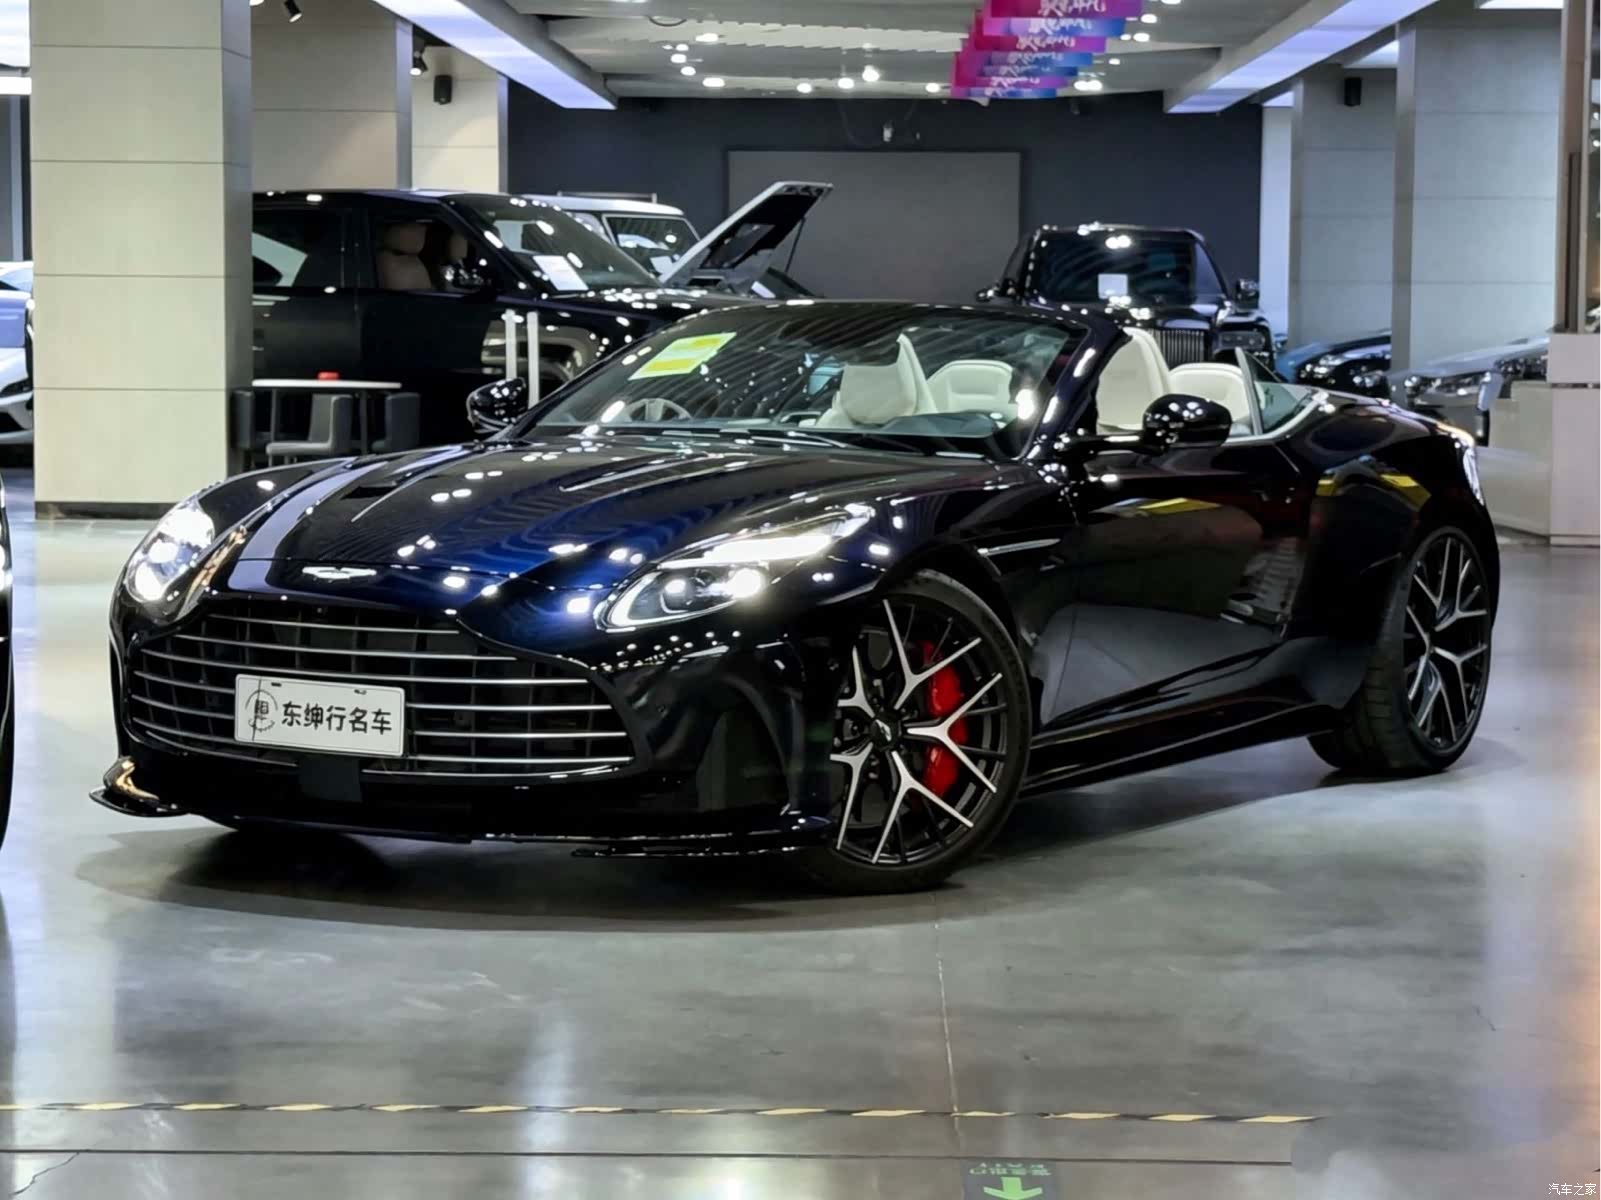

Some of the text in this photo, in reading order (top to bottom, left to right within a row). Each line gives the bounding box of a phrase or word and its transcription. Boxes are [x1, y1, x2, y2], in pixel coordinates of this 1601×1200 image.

[281, 701, 392, 735] 东绅行名车
